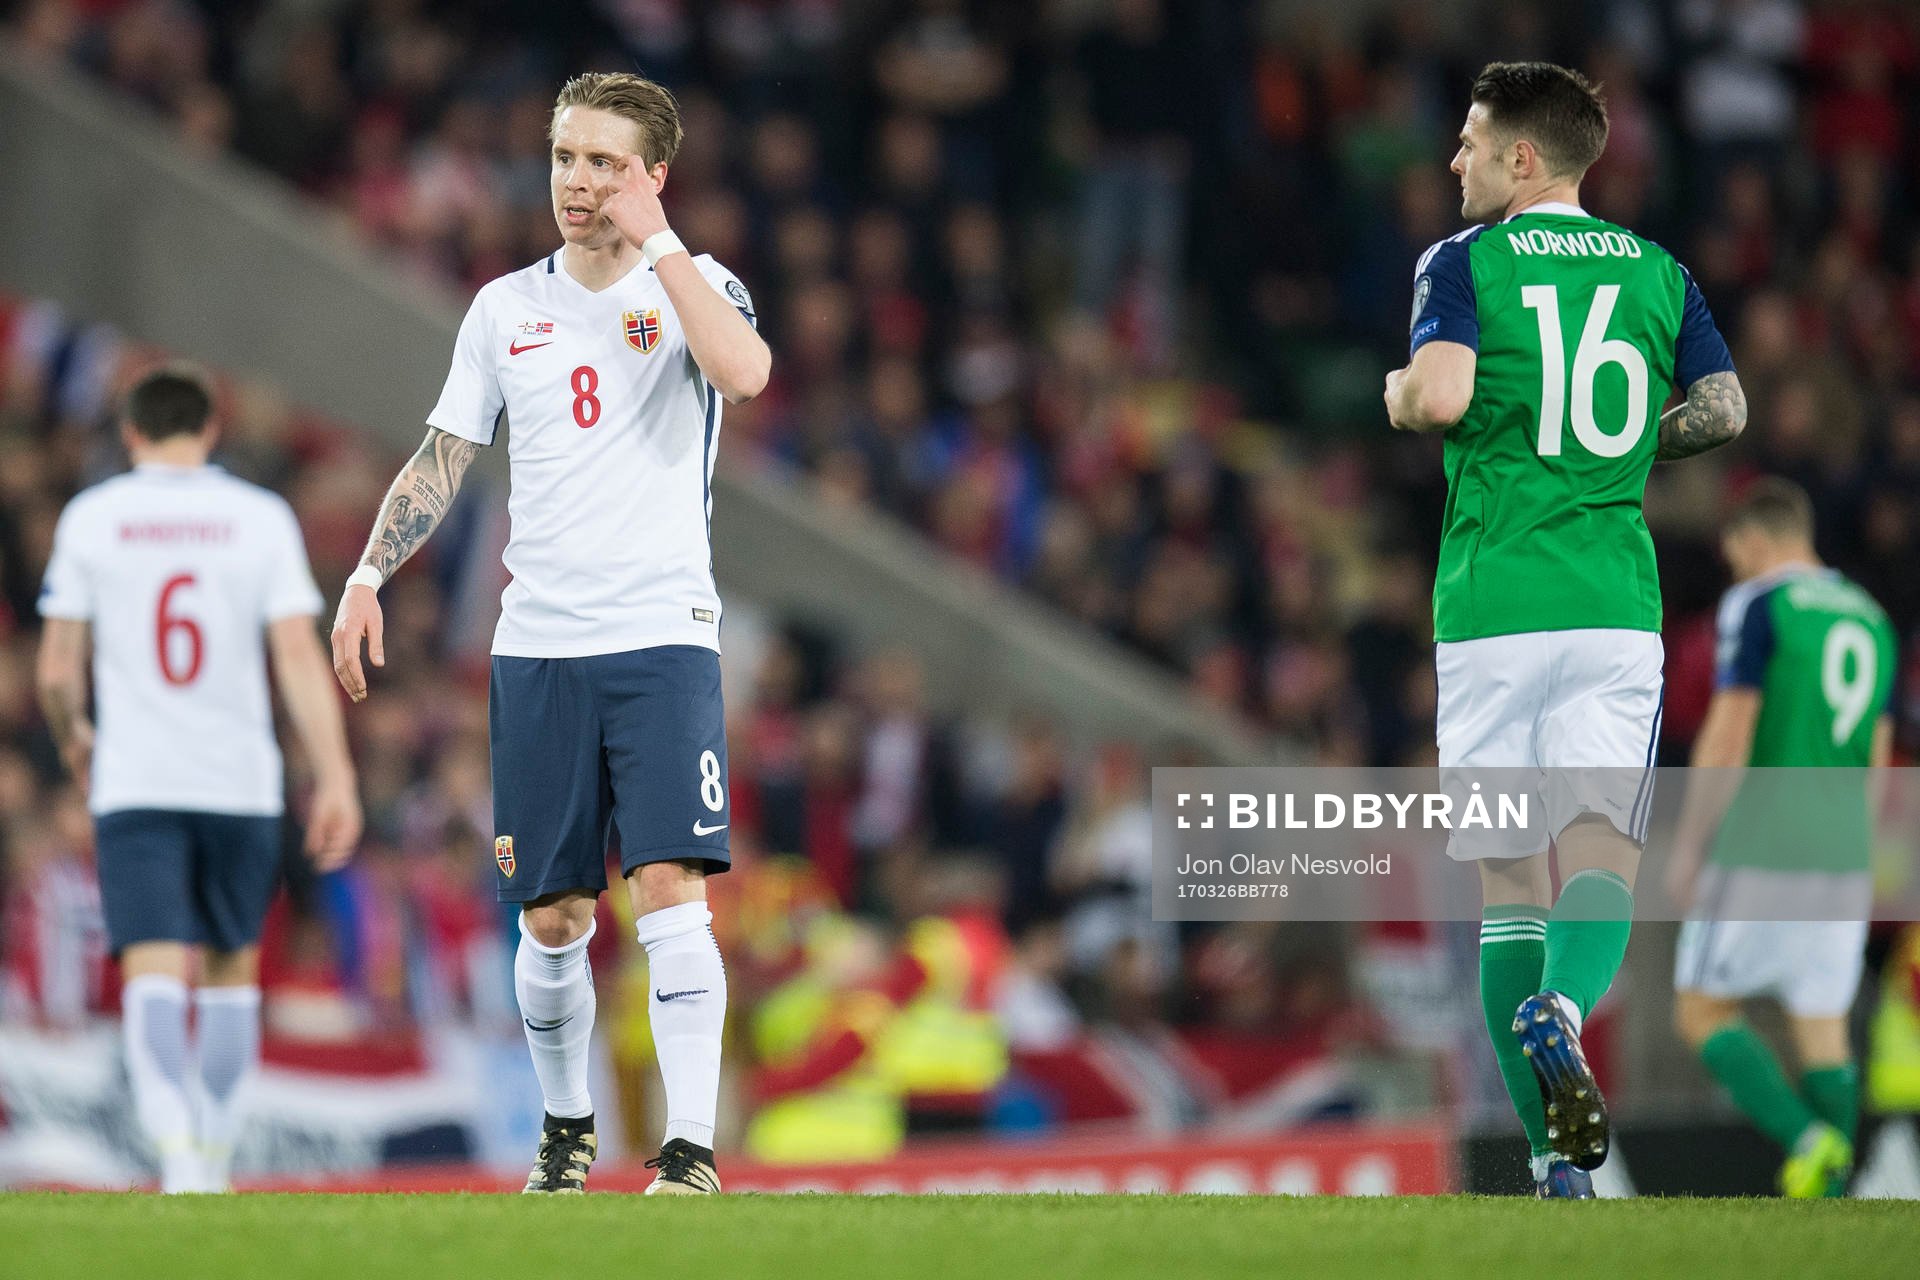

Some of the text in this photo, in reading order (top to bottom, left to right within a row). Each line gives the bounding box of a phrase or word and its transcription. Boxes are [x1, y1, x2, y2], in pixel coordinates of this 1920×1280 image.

[1507, 229, 1642, 259] NORWOOD
[570, 365, 601, 429] 8
[1521, 284, 1649, 458] 16
[154, 573, 204, 687] 6
[1822, 620, 1877, 744] 9
[699, 749, 725, 812] 8
